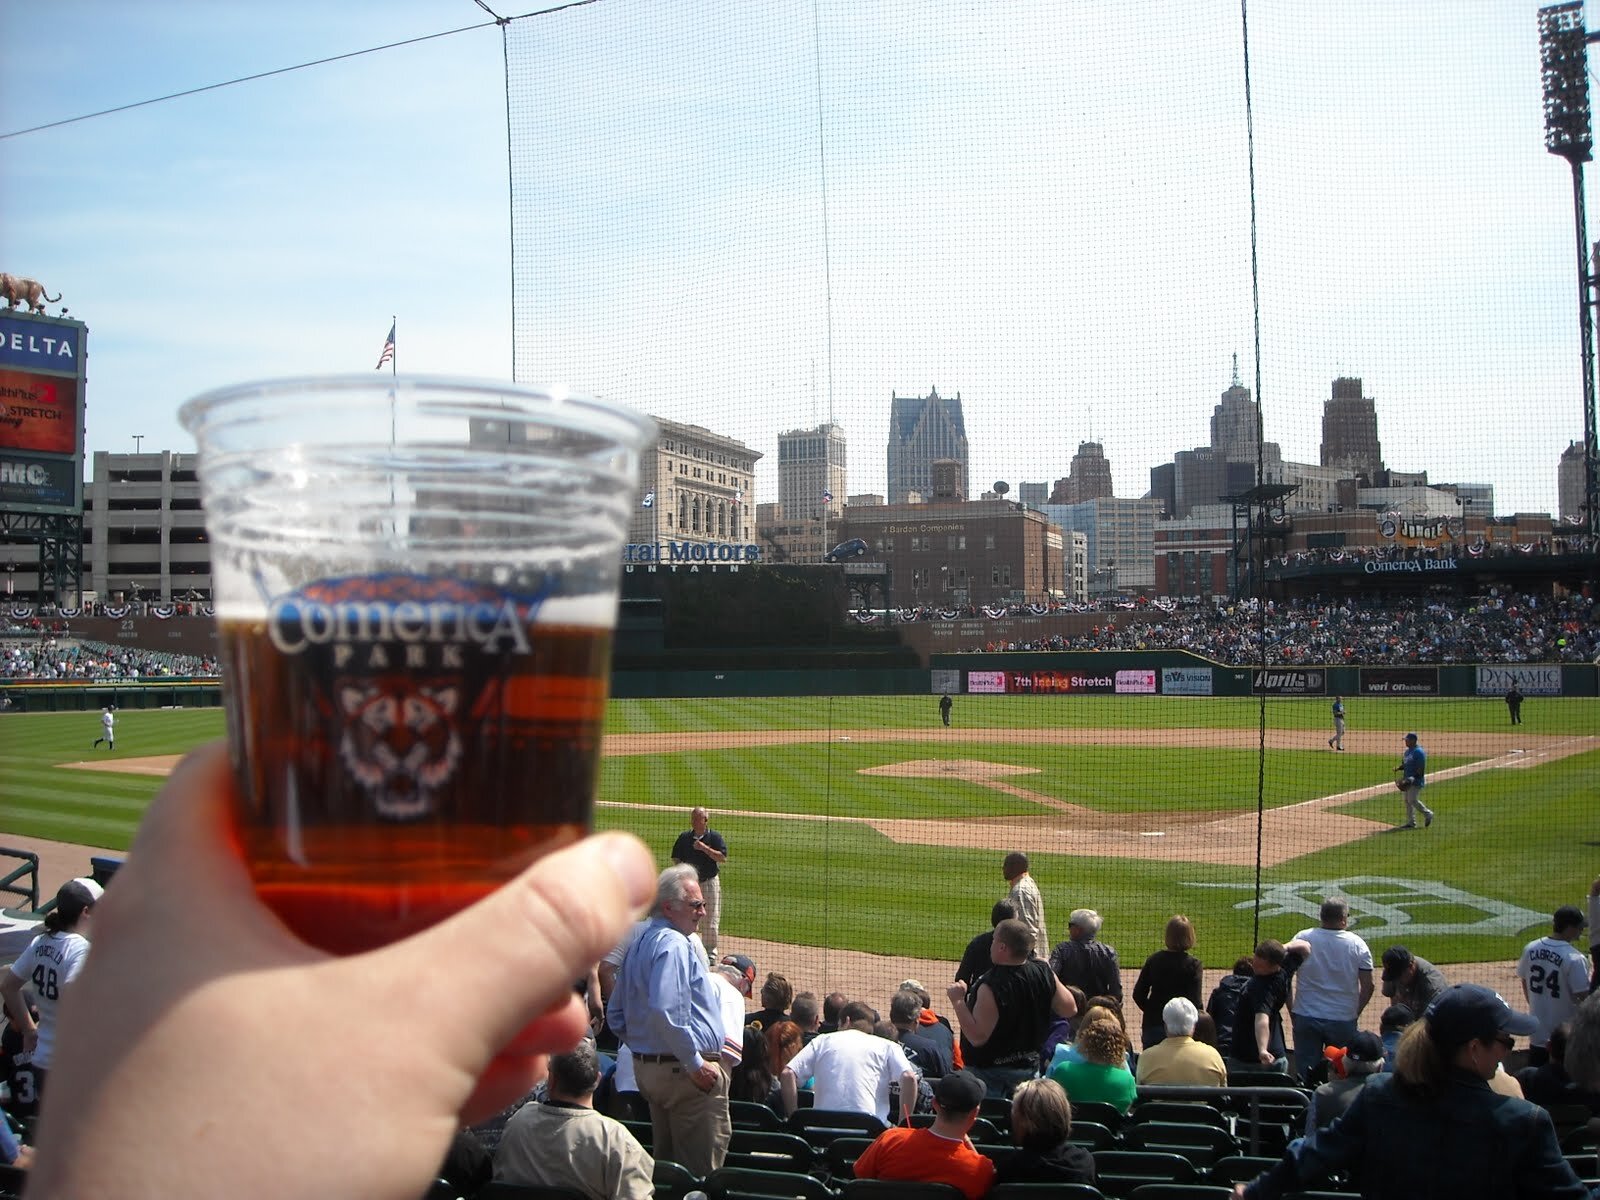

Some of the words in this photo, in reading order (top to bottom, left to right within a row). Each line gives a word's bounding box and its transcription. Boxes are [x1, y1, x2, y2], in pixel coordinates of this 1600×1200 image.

[10, 406, 62, 420] STRETCH
[921, 523, 965, 533] Companies
[1401, 521, 1443, 540] JUNGLE
[668, 541, 760, 562] Motors
[626, 565, 739, 573] UNTAIN
[1424, 558, 1458, 570] Bank
[121, 620, 134, 630] 23
[333, 644, 464, 668] PARK
[1014, 676, 1032, 687] 7th
[1034, 676, 1068, 689] Inning
[1071, 676, 1113, 687] Stretch
[1186, 674, 1211, 682] VISION
[1254, 670, 1299, 688] April
[1480, 668, 1559, 683] DYNAMIC
[1368, 681, 1405, 691] verion
[31, 963, 59, 1001] 48
[1529, 964, 1560, 999] 24
